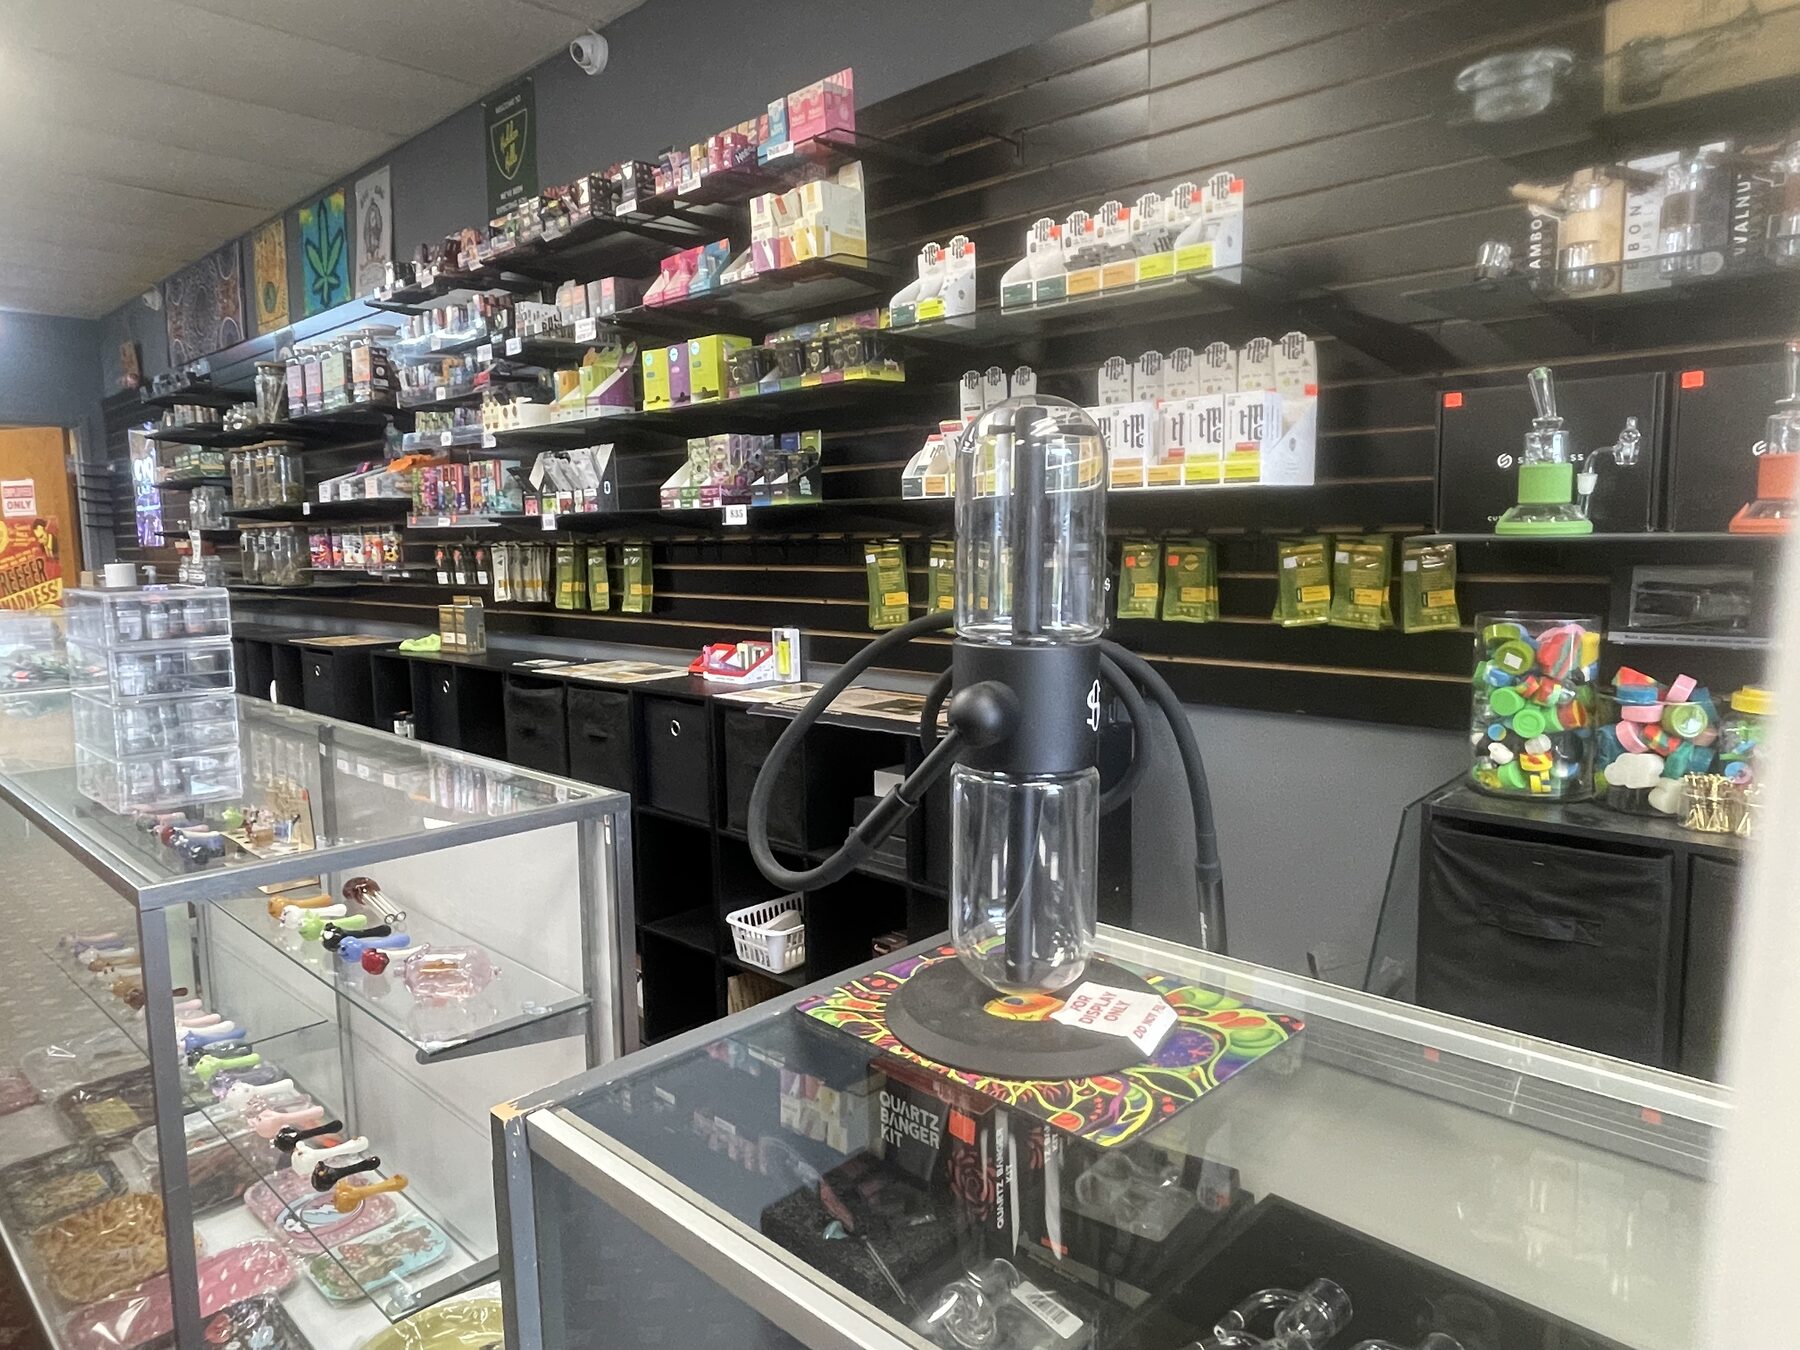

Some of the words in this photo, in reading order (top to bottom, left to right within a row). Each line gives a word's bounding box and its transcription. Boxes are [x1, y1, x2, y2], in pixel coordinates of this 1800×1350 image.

[1733, 174, 1751, 256] WALNU
[1529, 216, 1543, 269] AMBO
[6, 500, 32, 511] ONLY
[0, 558, 48, 597] REEFER
[1070, 994, 1092, 1012] FOR
[1079, 991, 1117, 1025] DISPLAY
[1104, 1000, 1131, 1022] ONLY
[1133, 1025, 1147, 1040] DO
[1141, 1012, 1157, 1026] NOT
[1152, 1001, 1167, 1014] FIL
[879, 1090, 940, 1132] QUARTZ
[880, 1106, 940, 1149] BANGER
[881, 1123, 903, 1148] KIT
[995, 1127, 1004, 1176] BANGER
[996, 1179, 1004, 1230] QUARTZ
